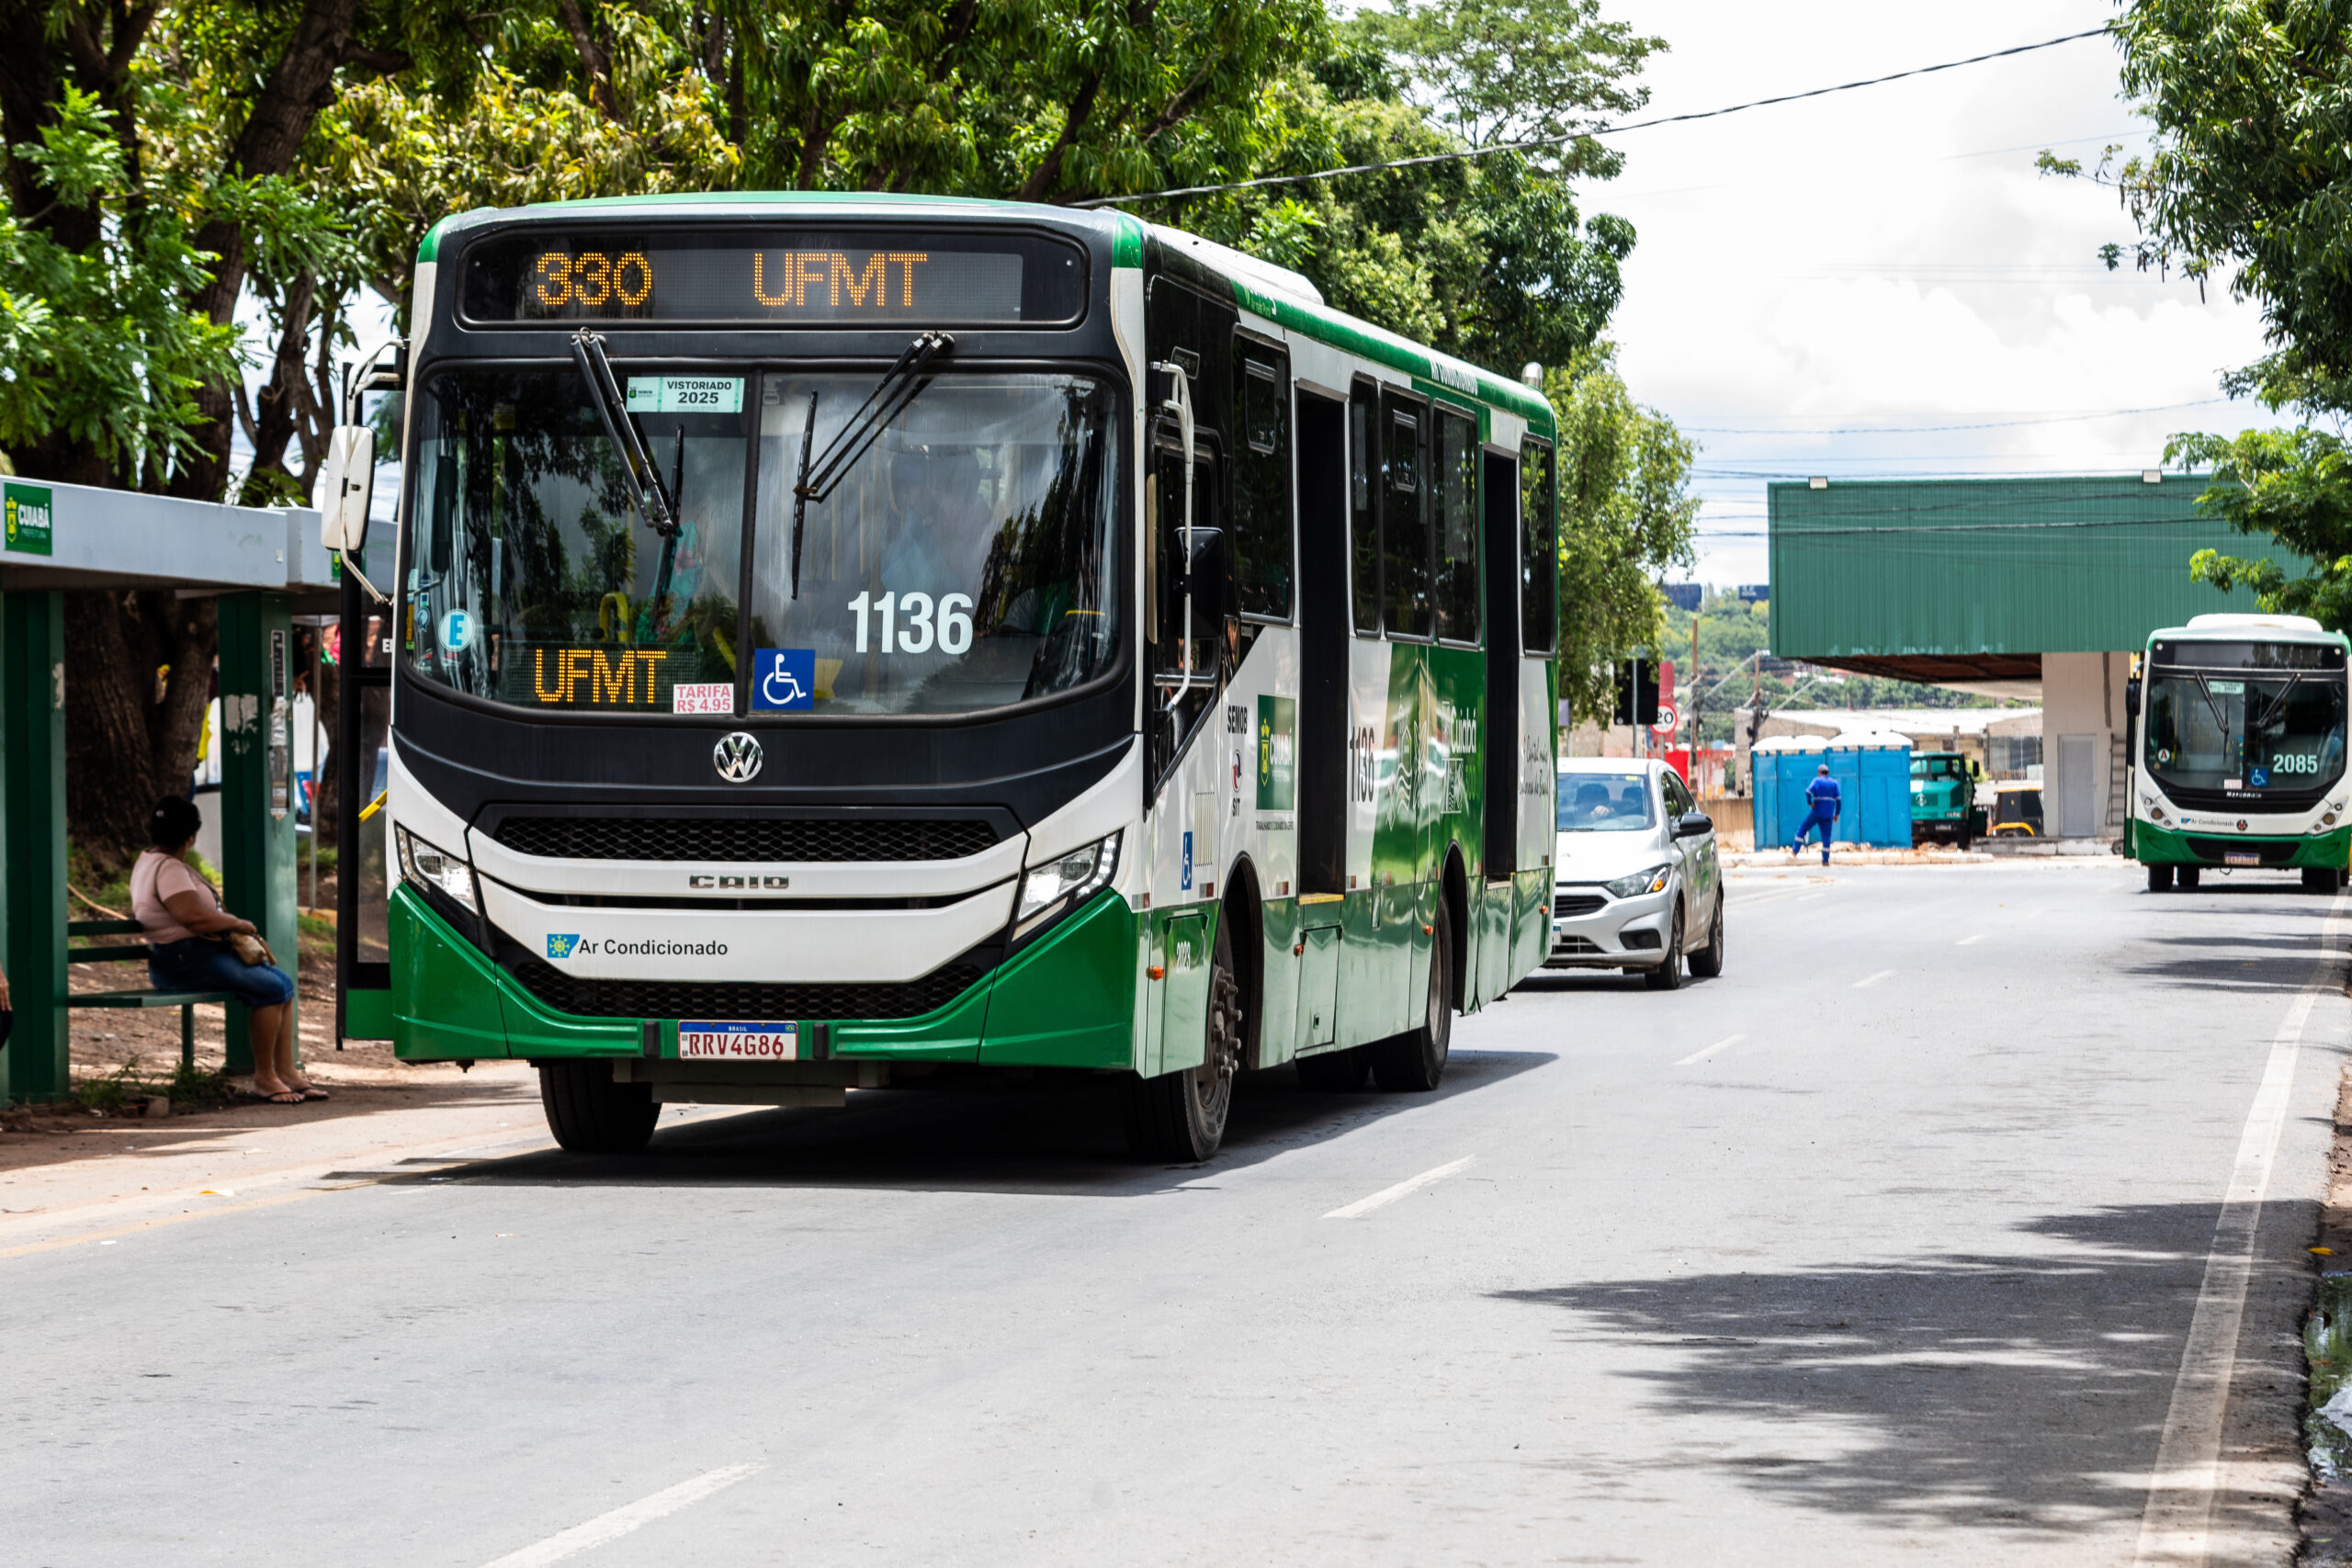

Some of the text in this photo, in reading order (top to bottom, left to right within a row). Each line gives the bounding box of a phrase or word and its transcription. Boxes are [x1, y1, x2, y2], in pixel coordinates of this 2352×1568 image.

[537, 252, 928, 307] 330 UFMT
[667, 380, 732, 390] VISTORIADO
[677, 391, 719, 404] 2025
[17, 502, 50, 528] CUIABÁ
[448, 614, 465, 646] E
[847, 590, 974, 655] 1136
[535, 649, 668, 704] UFMT
[676, 684, 730, 698] TARIFA
[676, 698, 730, 713] R$ 4,95
[1227, 705, 1248, 735] SEMOB
[1451, 705, 1477, 754] Cuiabá
[1269, 728, 1293, 767] CUIABÁ
[2160, 749, 2168, 760] A
[1349, 726, 1375, 803] 1136
[2272, 753, 2319, 773] 2085
[1232, 797, 1241, 817] SIT
[689, 875, 789, 889] CAIO
[579, 939, 728, 955] Ar Condicionado
[689, 1033, 785, 1056] RRV4G86
